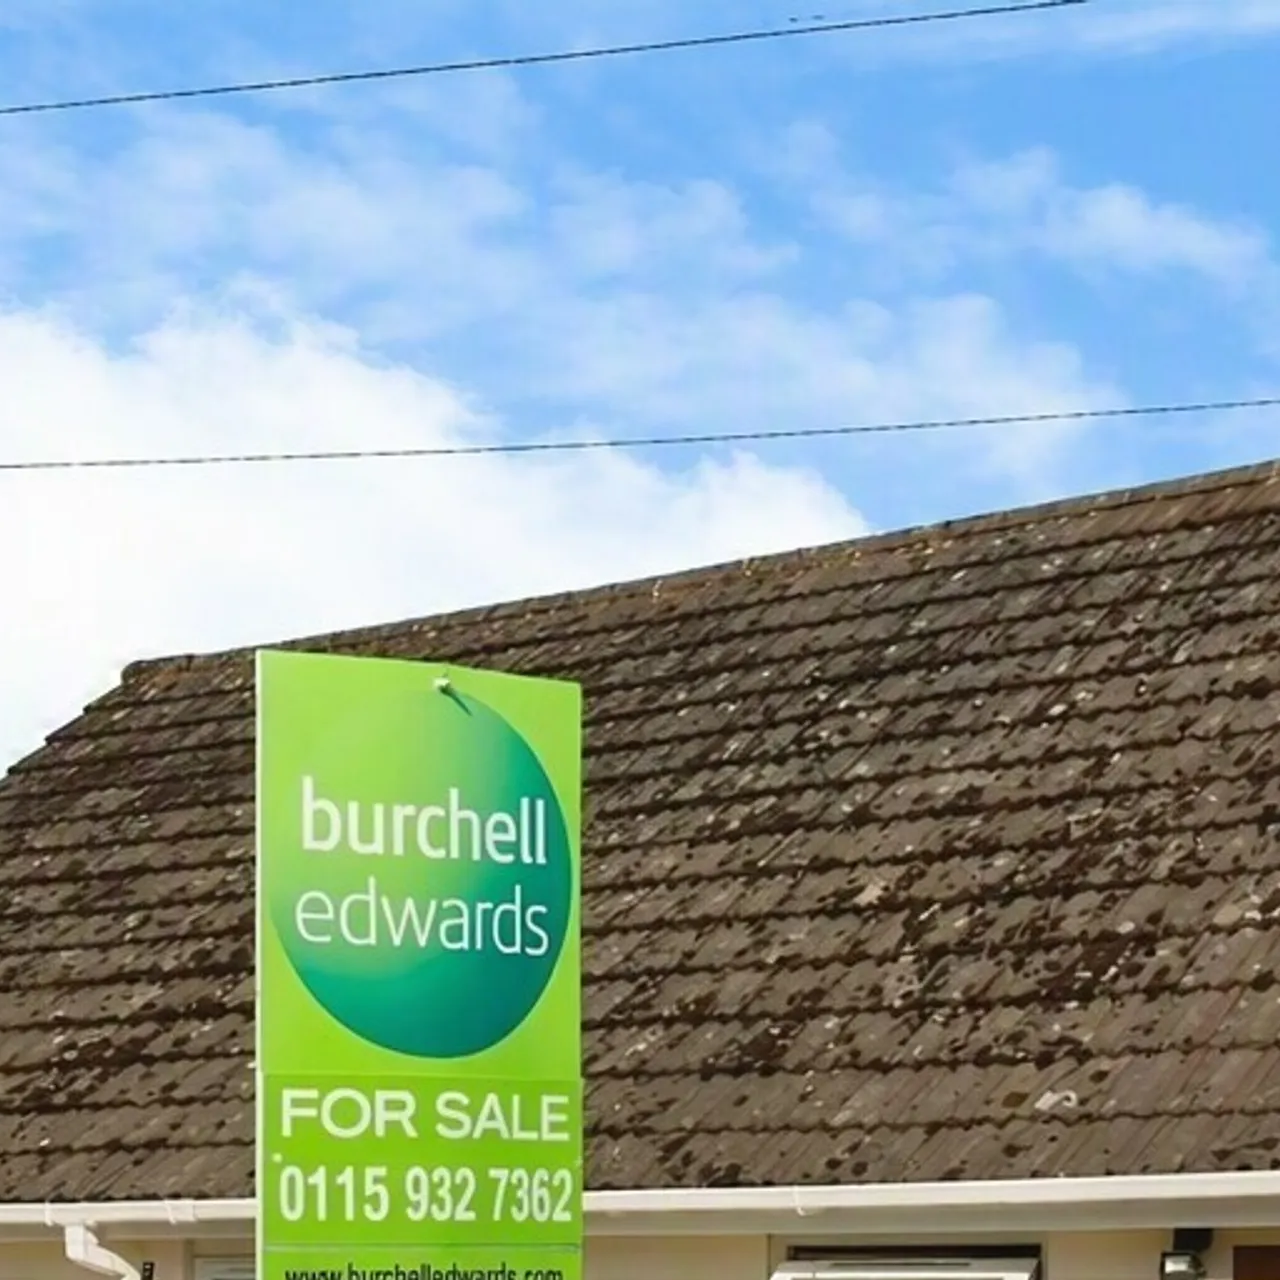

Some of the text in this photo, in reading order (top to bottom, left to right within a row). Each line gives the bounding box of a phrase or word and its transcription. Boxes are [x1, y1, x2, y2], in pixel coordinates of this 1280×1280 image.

[301, 774, 547, 865] burchell
[295, 875, 549, 957] edwards
[281, 1087, 569, 1142] FOR SALE
[279, 1164, 572, 1223] 0115 932 7362
